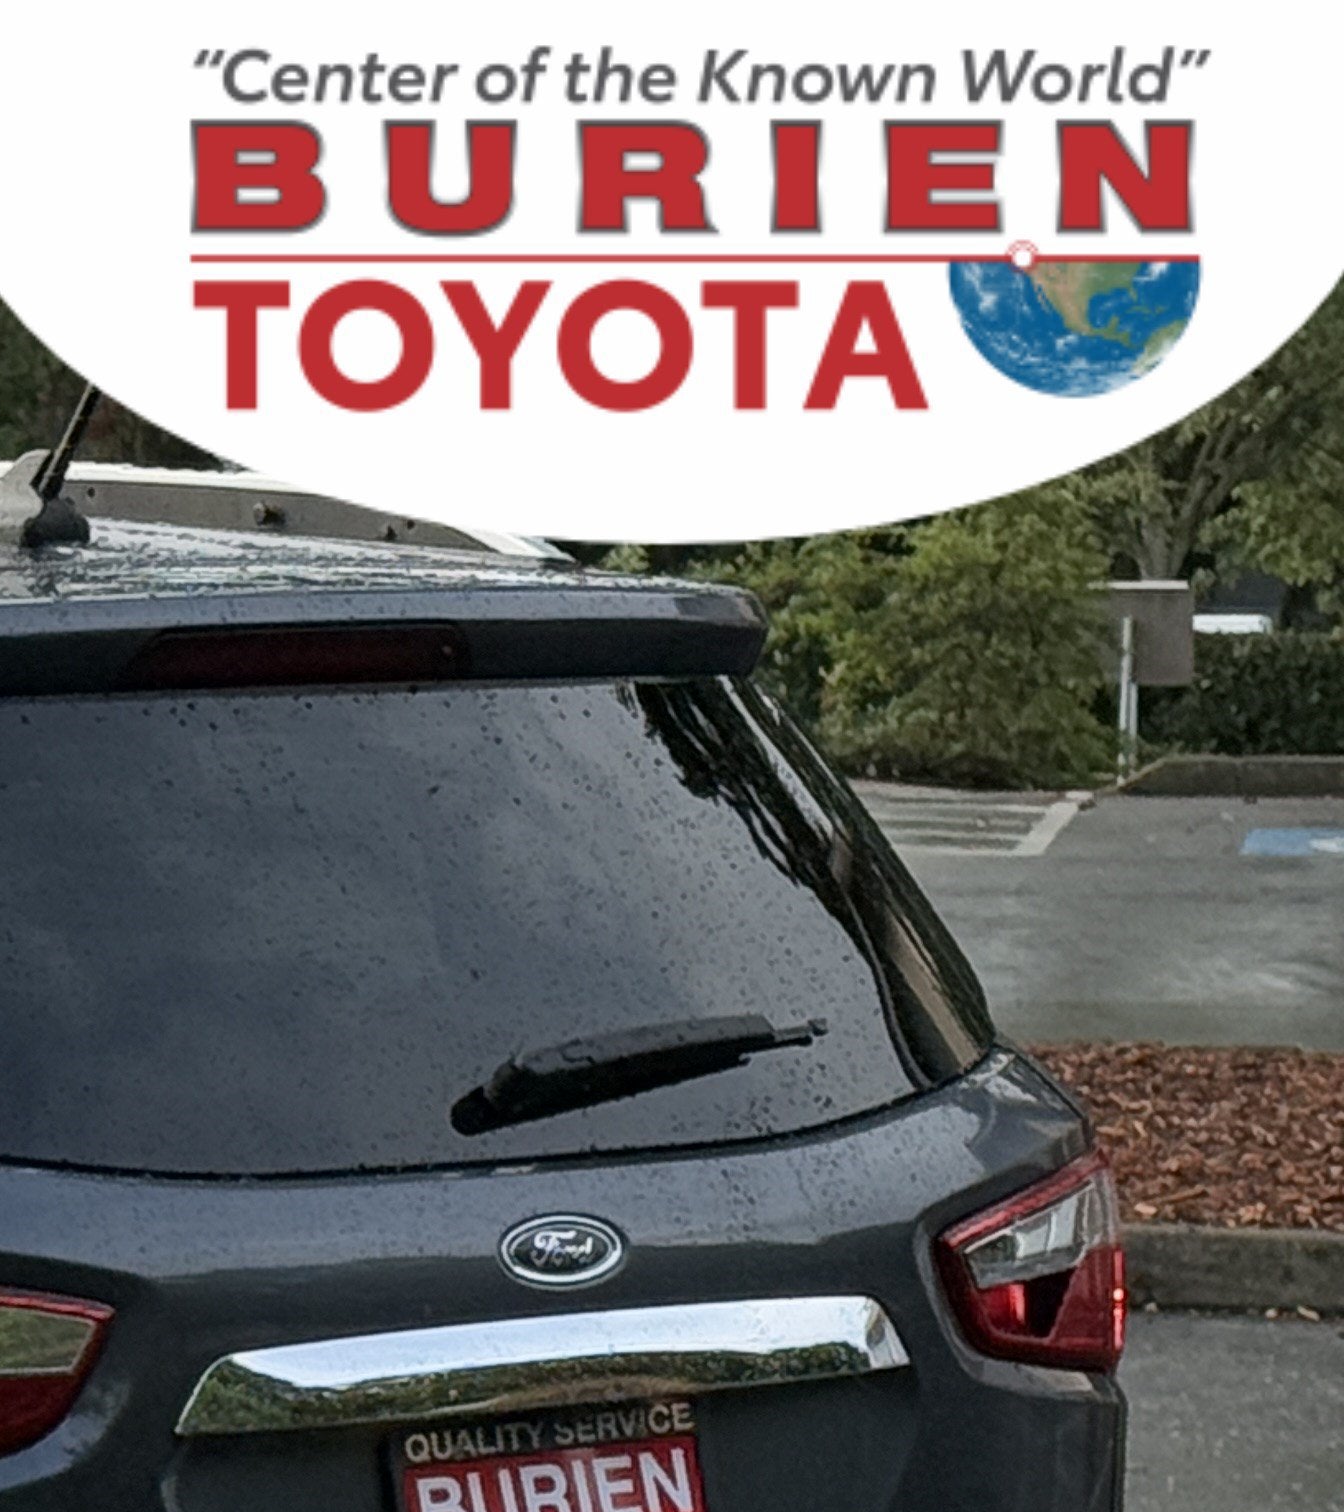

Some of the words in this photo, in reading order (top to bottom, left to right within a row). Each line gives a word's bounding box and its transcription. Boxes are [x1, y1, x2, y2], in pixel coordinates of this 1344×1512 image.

[530, 1230, 594, 1268] Ford
[404, 1420, 545, 1464] QUALITY
[553, 1402, 696, 1446] SERVICE
